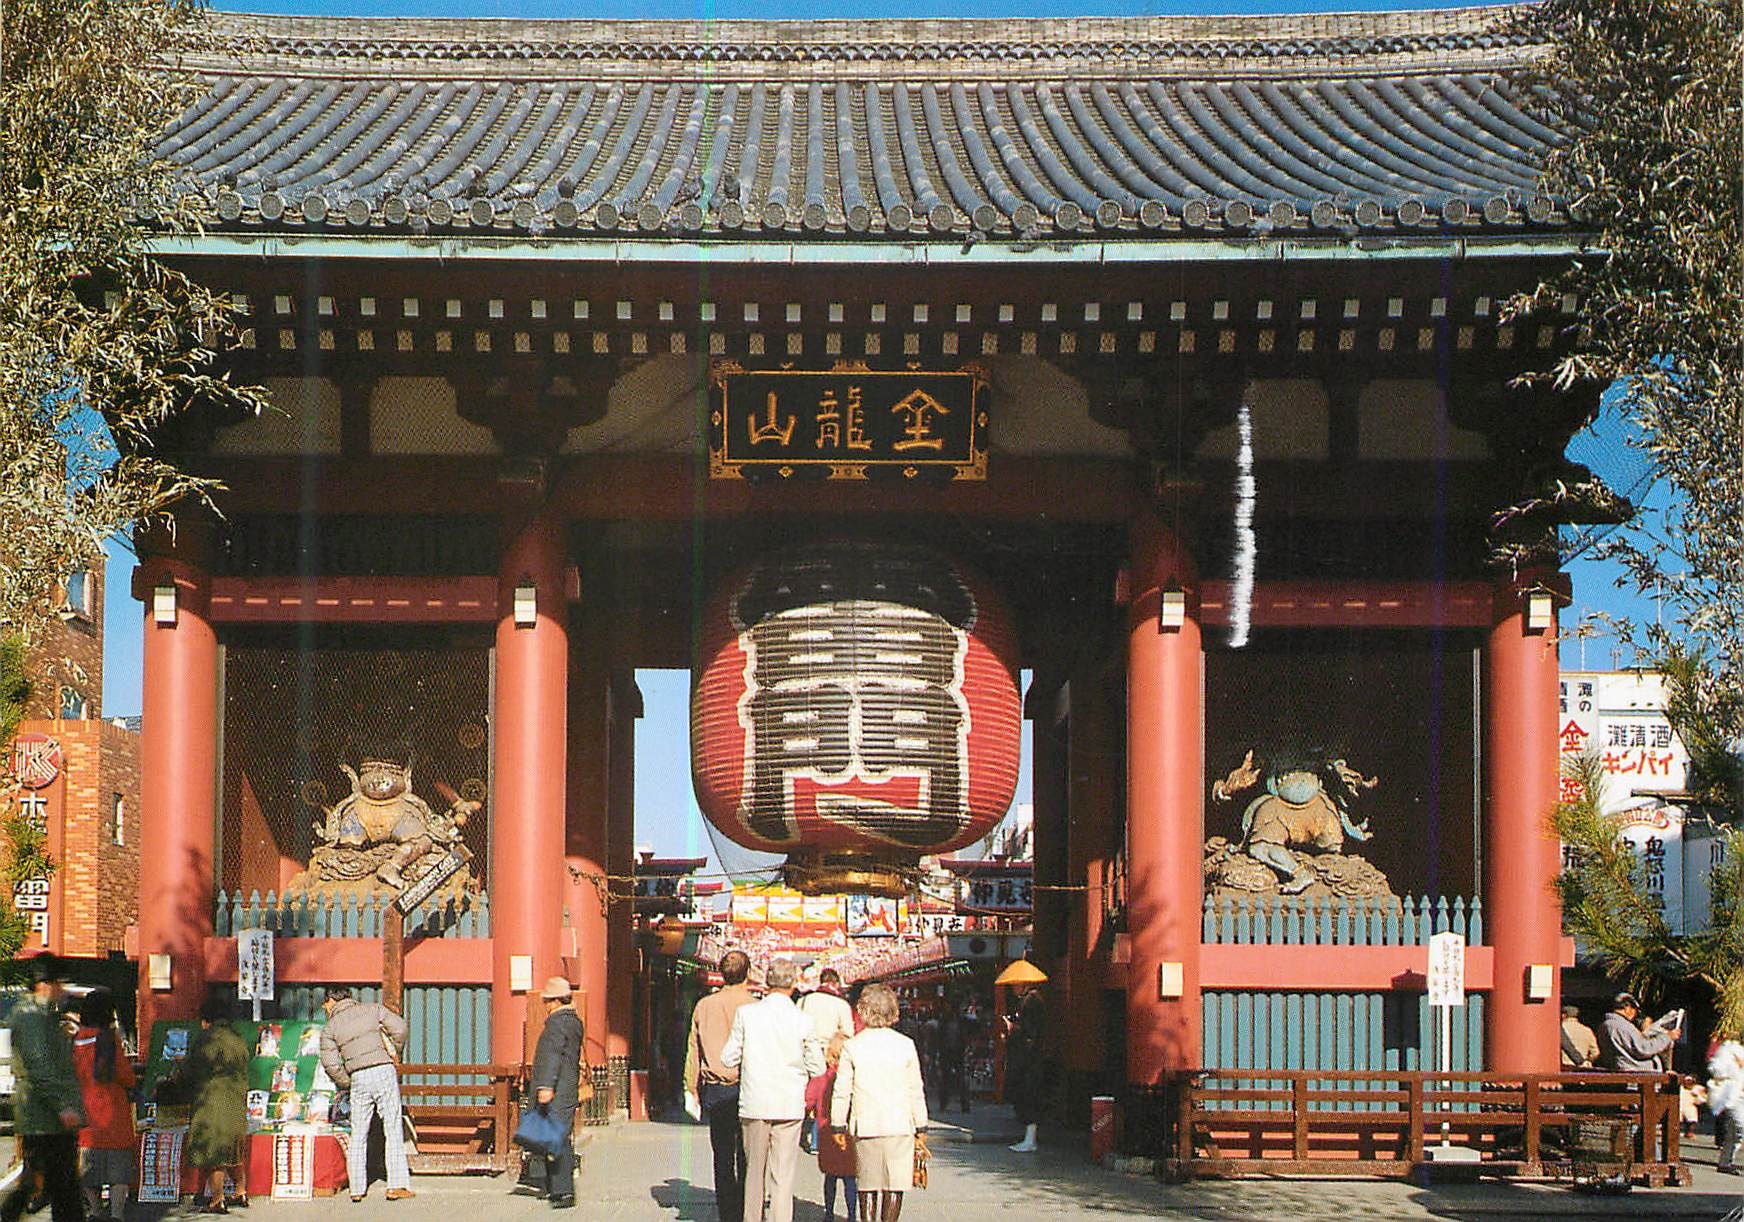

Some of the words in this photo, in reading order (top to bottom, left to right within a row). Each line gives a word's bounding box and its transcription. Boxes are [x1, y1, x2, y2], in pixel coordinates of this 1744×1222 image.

[747, 385, 951, 451] 金龍山
[728, 560, 979, 847] 雷門
[1602, 751, 1674, 775] キンパイ
